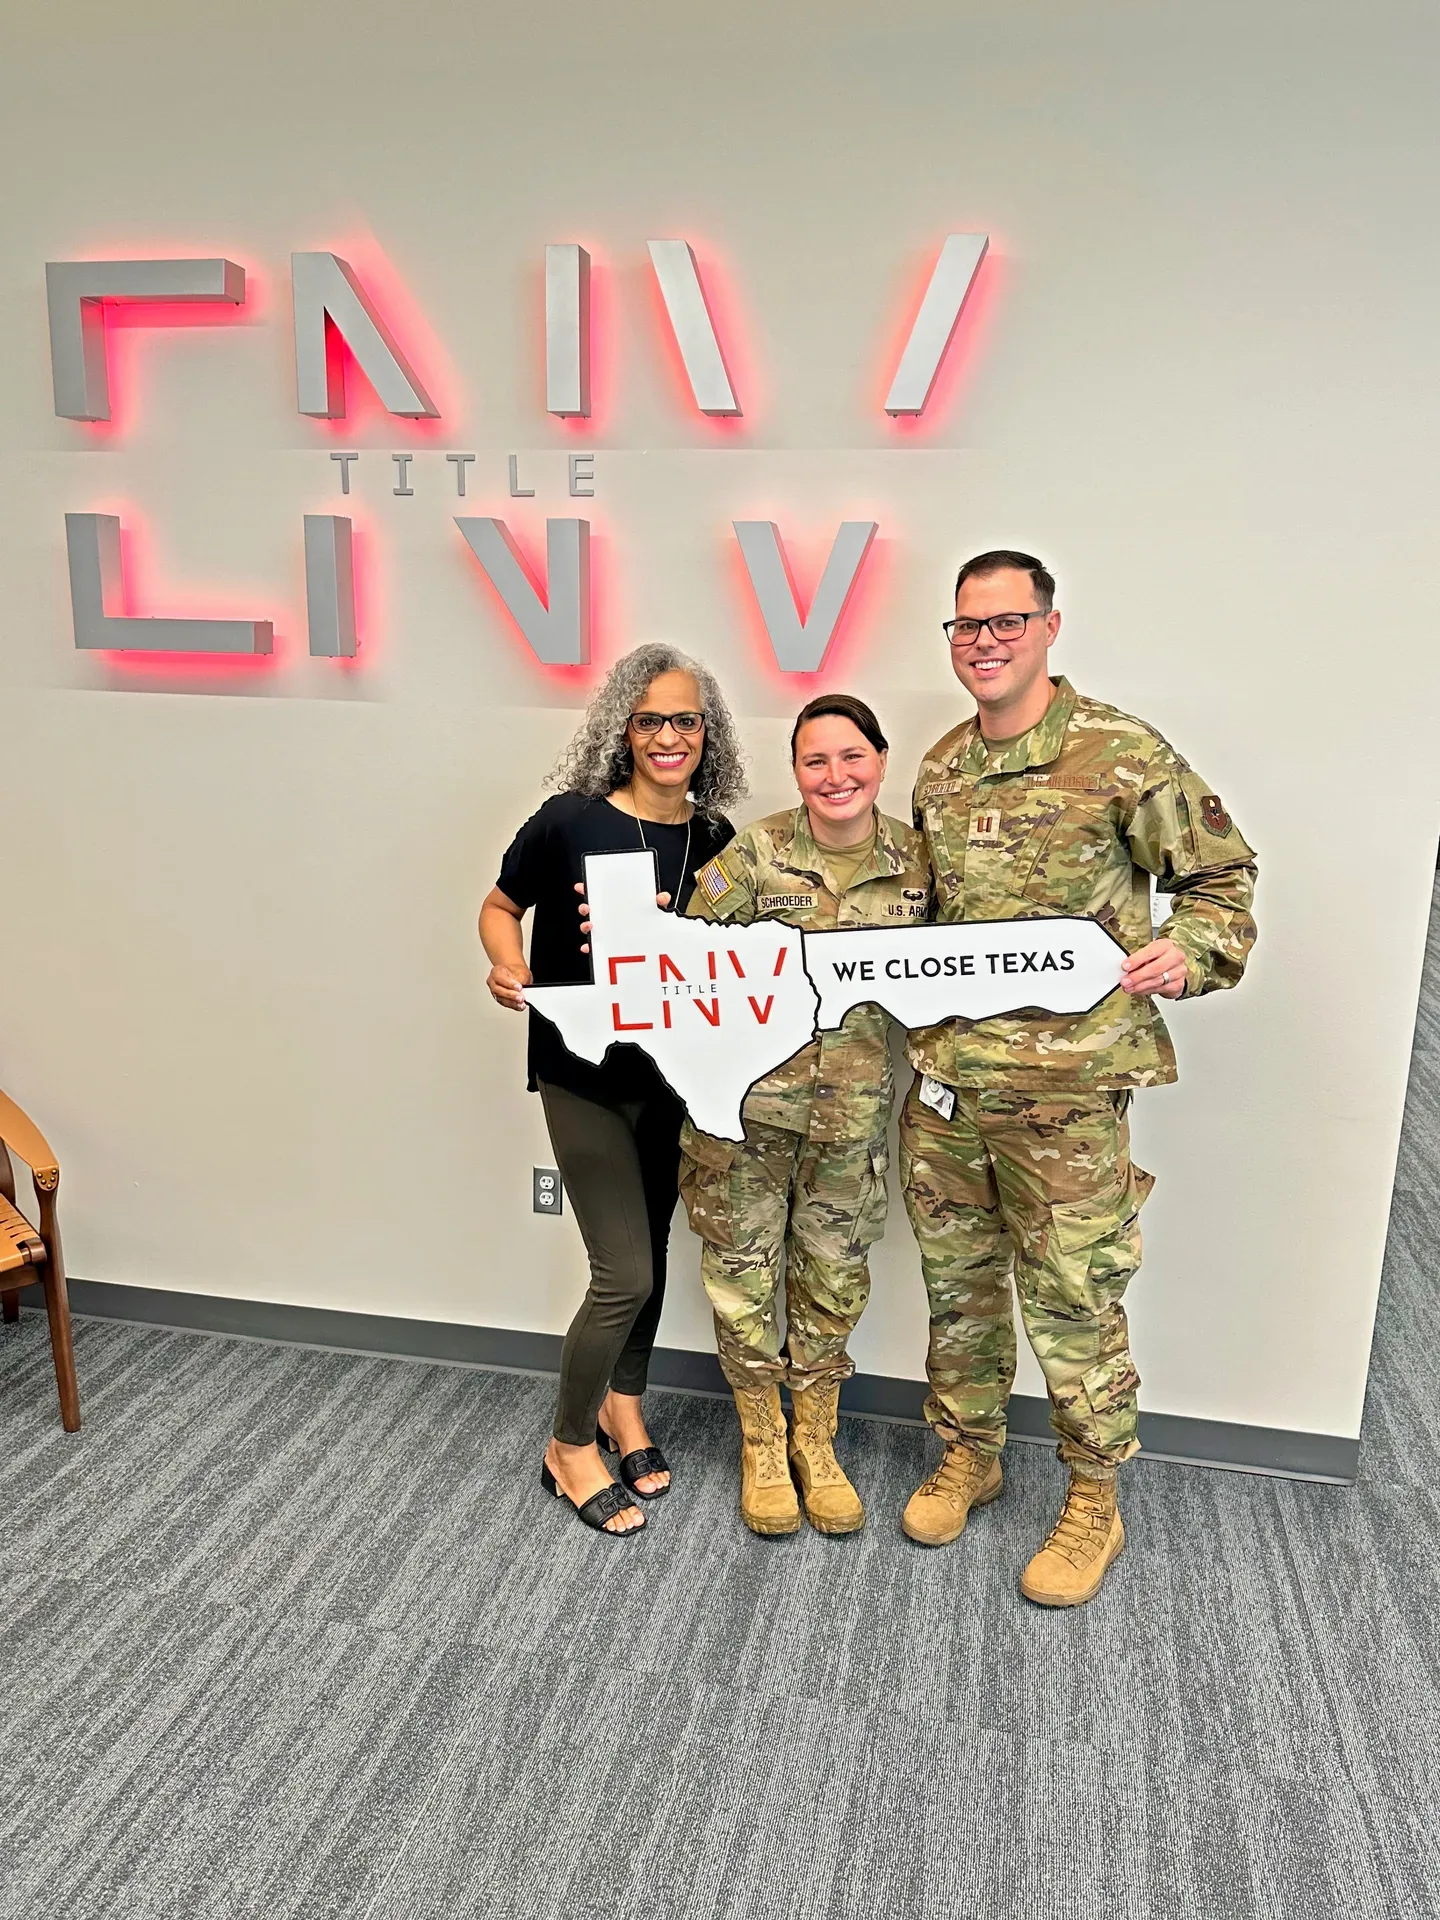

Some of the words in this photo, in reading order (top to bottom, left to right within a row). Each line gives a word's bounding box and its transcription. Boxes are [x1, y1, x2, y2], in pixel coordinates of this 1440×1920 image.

[330, 453, 595, 497] TITLE
[761, 895, 813, 908] SCHROEDER
[888, 904, 906, 917] U.S.
[908, 905, 929, 918] ARM
[832, 960, 876, 982] WE
[885, 955, 975, 979] CLOSE
[985, 950, 1075, 975] TEXAS
[661, 983, 717, 995] TITLE
